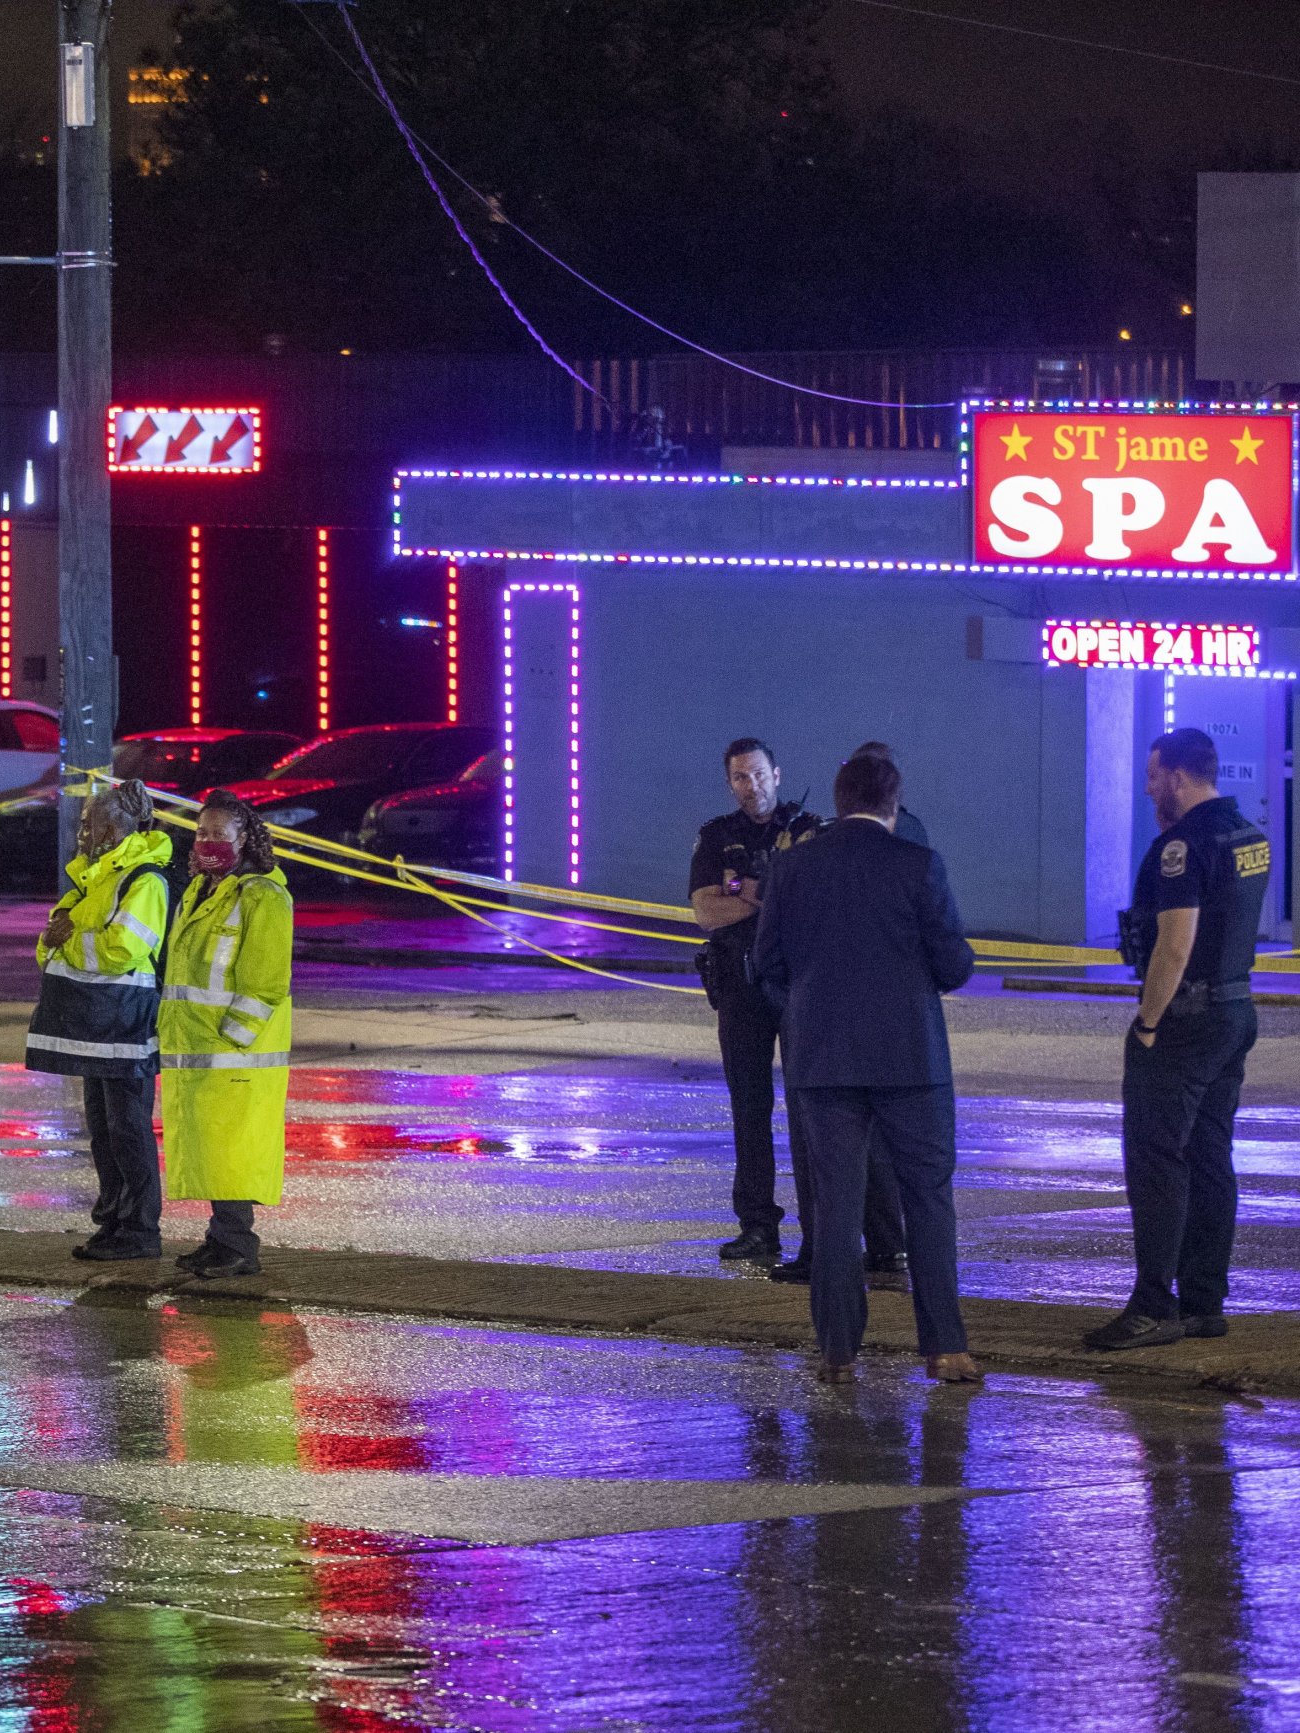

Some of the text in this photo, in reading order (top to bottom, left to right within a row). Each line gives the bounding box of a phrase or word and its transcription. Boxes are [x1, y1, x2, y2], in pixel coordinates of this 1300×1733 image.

[1053, 425, 1209, 472] ST jame
[988, 475, 1278, 564] SPA
[1052, 627, 1252, 666] OPEN 24 HR
[1239, 765, 1253, 779] IN
[1235, 846, 1271, 872] POLICE
